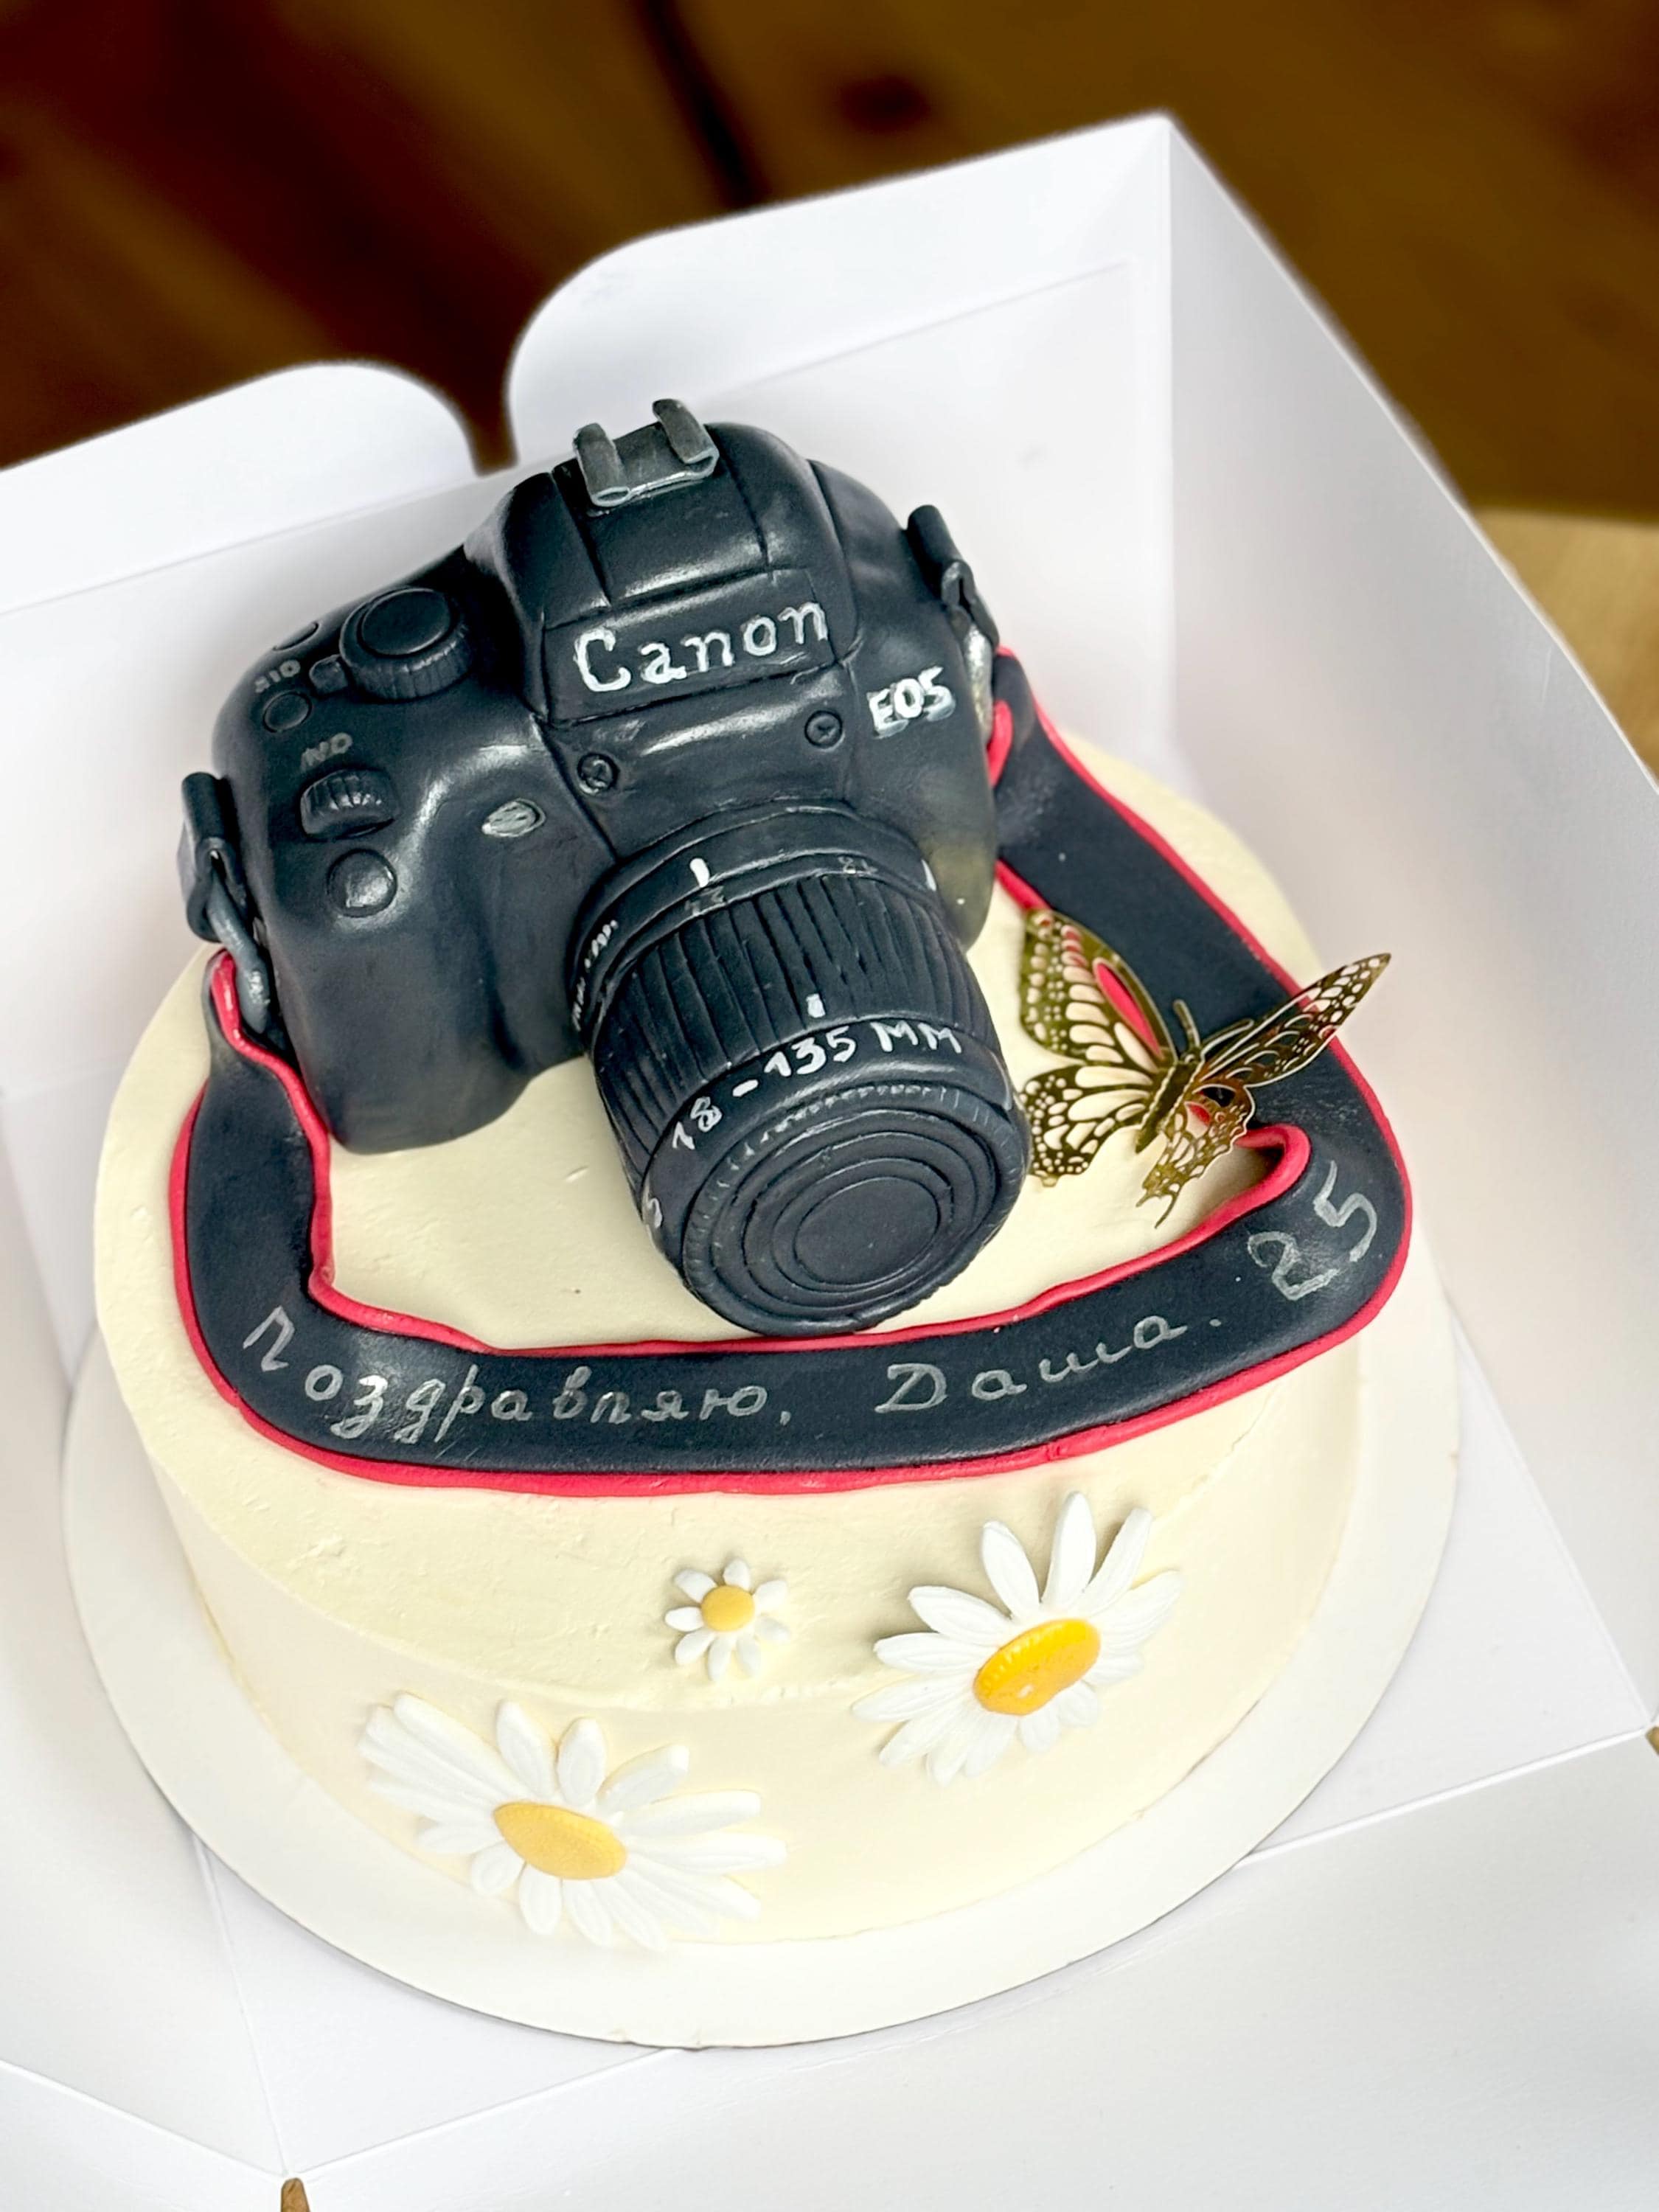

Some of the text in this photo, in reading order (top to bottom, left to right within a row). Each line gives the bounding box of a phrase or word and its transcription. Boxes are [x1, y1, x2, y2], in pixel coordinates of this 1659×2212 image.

[573, 602, 830, 692] Canon
[866, 667, 956, 738] EOS
[1248, 1161, 1377, 1301] 25
